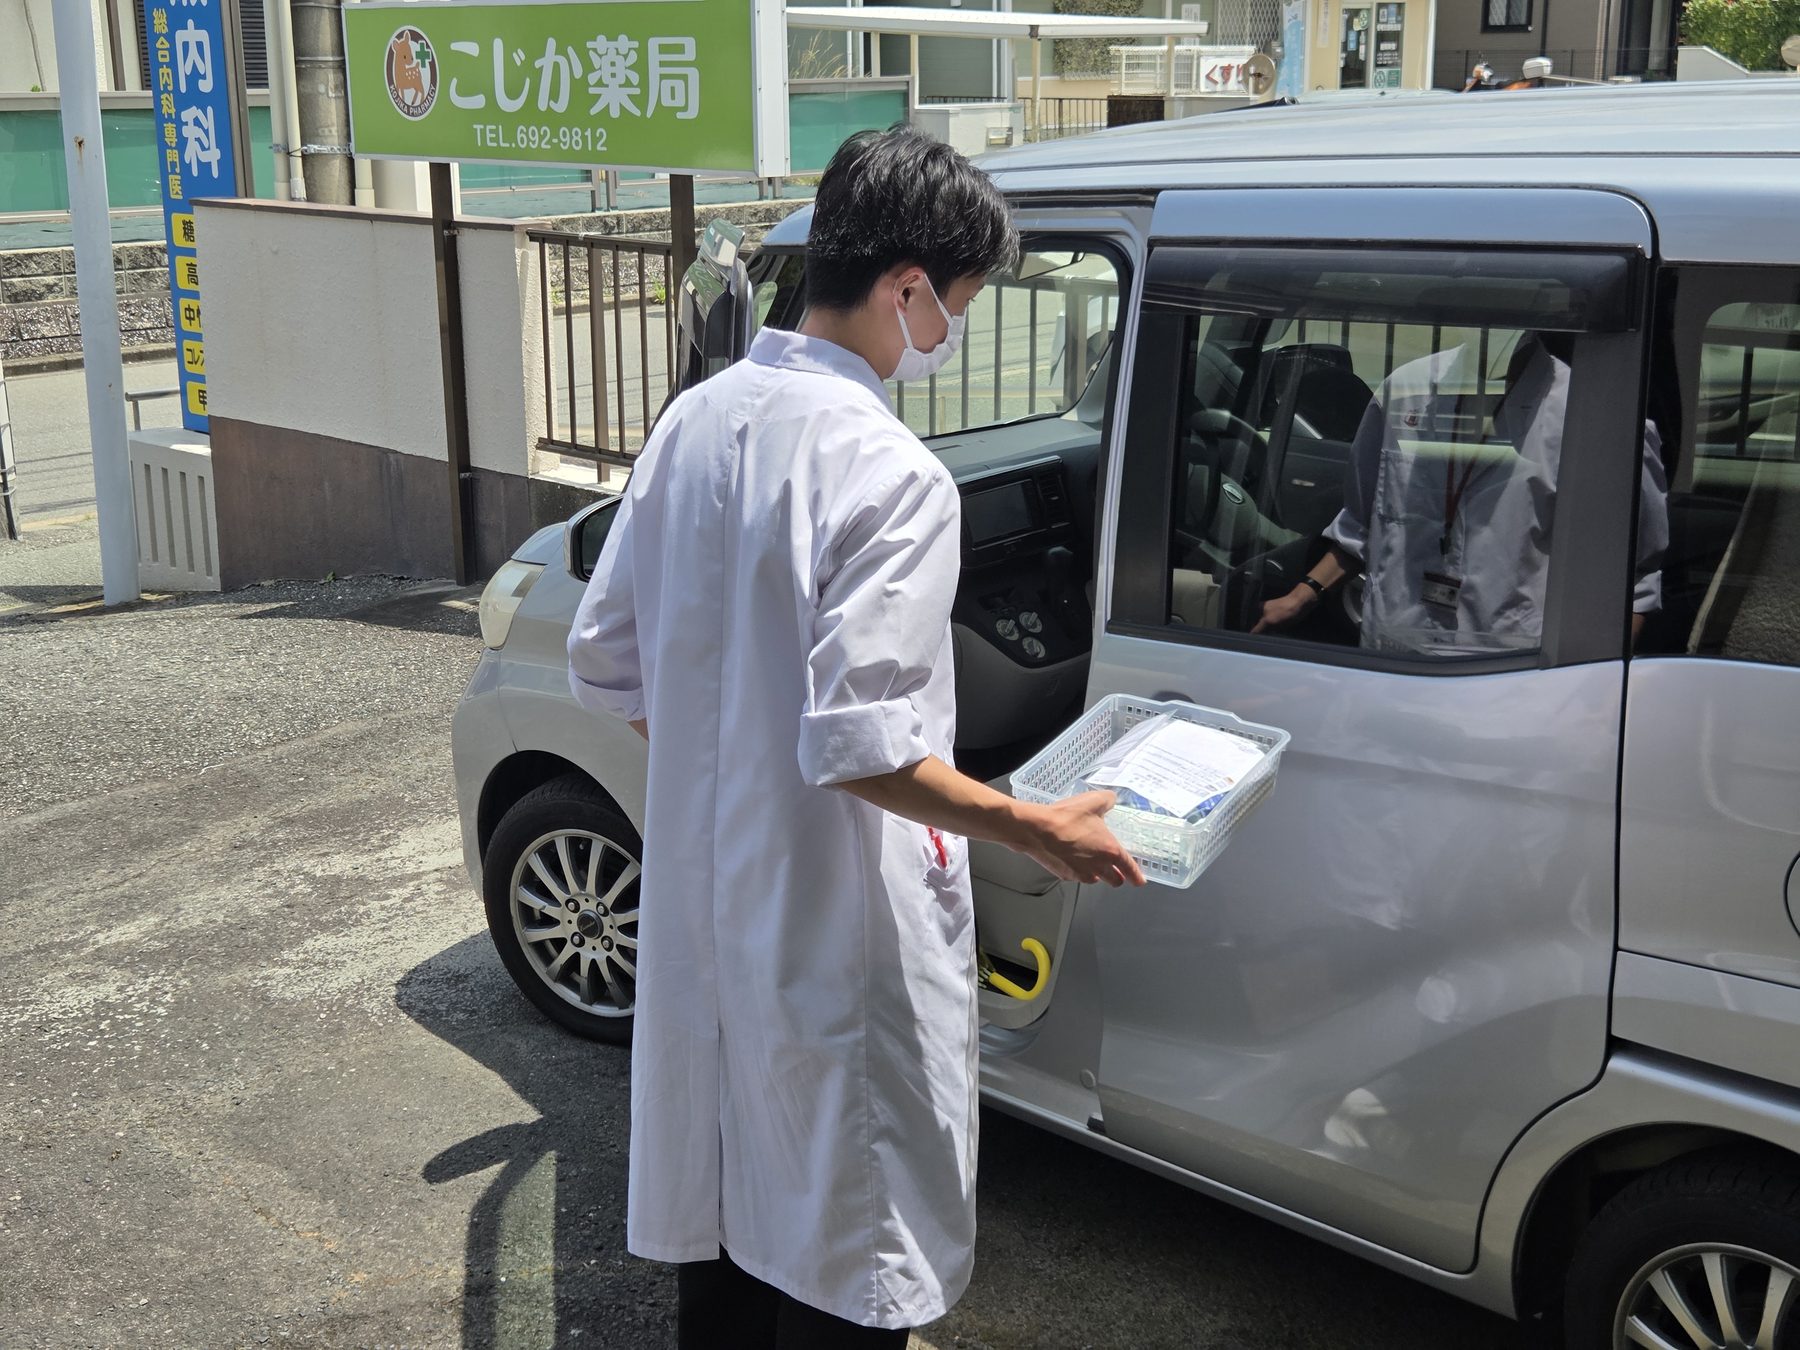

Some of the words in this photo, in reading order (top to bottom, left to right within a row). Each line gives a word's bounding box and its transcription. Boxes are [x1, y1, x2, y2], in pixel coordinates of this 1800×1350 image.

[152, 7, 183, 200] 総合内科専門医
[168, 0, 221, 178] 内科
[389, 84, 408, 114] KOJIKA
[409, 83, 437, 116] PHARMACY
[449, 34, 700, 120] こじか薬局
[473, 124, 607, 151] TEL.692-9812
